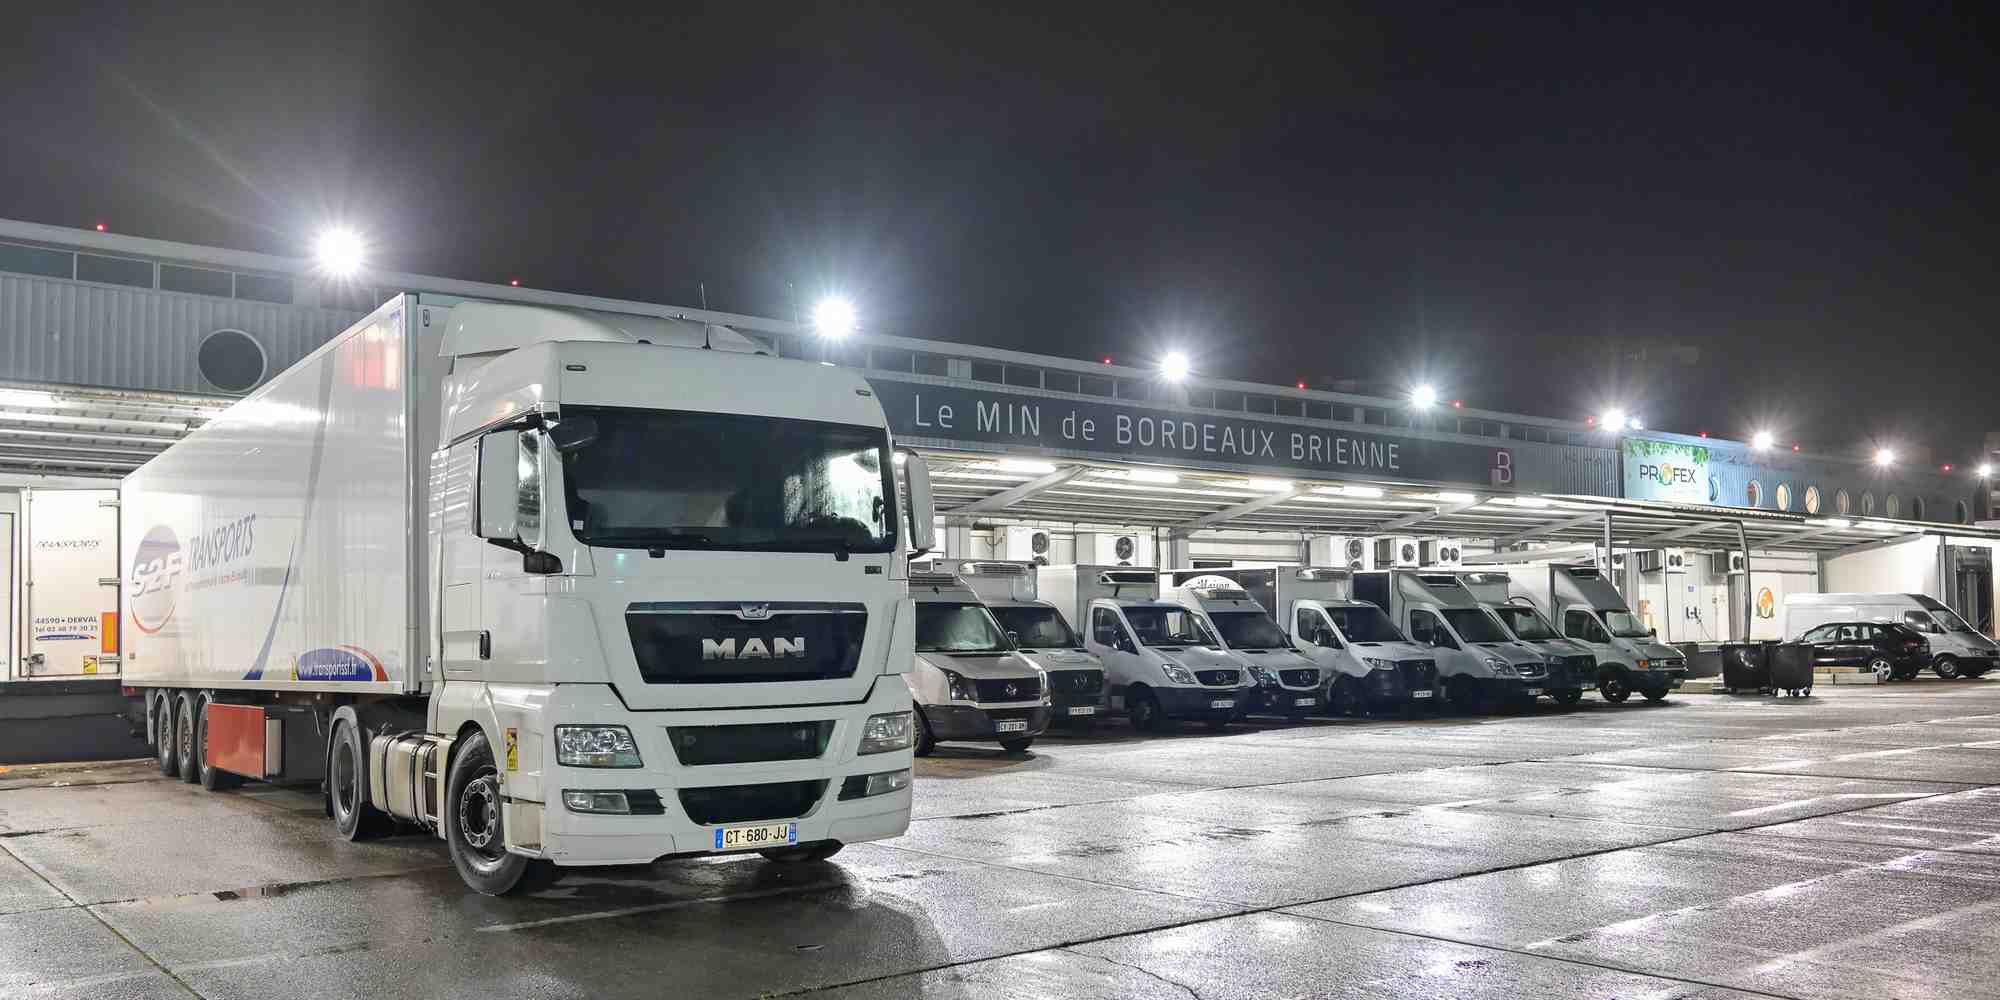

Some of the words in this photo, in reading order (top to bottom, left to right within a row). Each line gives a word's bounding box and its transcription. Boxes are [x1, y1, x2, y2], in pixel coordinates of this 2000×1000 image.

[915, 394, 953, 429] Le
[976, 400, 1040, 436] MIN
[1062, 410, 1095, 441] de
[1115, 414, 1275, 458] BORDEAUX
[1290, 432, 1400, 470] BRIENNE
[1496, 451, 1512, 483] B
[1639, 463, 1697, 485] PROFEX
[188, 511, 256, 572] TRANSPORTS
[130, 553, 182, 598] S2F
[67, 615, 98, 624] DERVAL
[702, 637, 805, 660] MAN
[725, 825, 788, 844] CT-680-JJ
